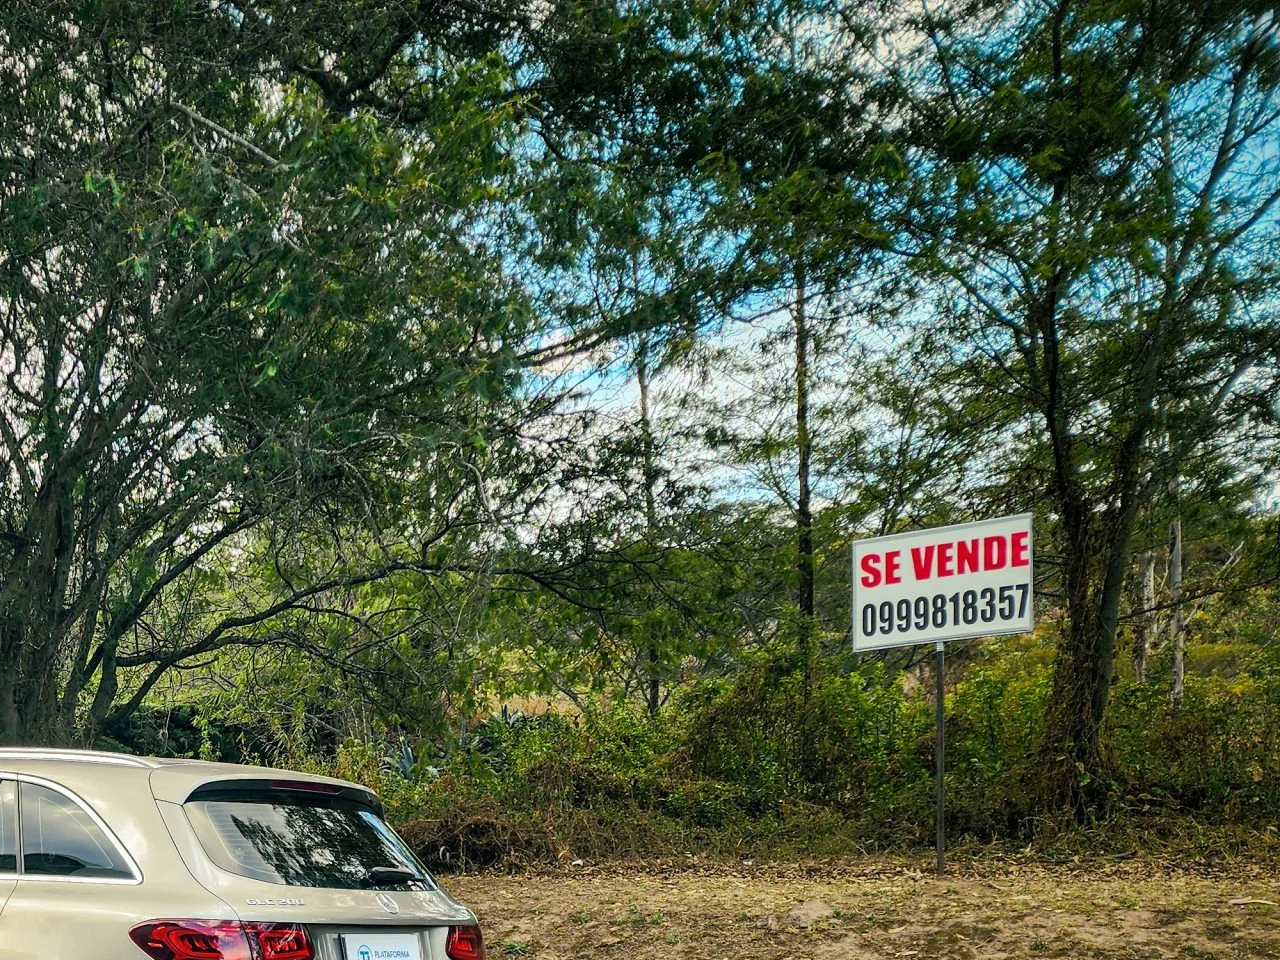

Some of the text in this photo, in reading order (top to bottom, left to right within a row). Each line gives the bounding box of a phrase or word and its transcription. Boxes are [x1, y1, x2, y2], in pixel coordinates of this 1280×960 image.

[860, 531, 1030, 588] SE VENDE
[862, 583, 1030, 637] 0999818357
[246, 898, 276, 906] GLC
[374, 950, 410, 959] PLATAFORMA
